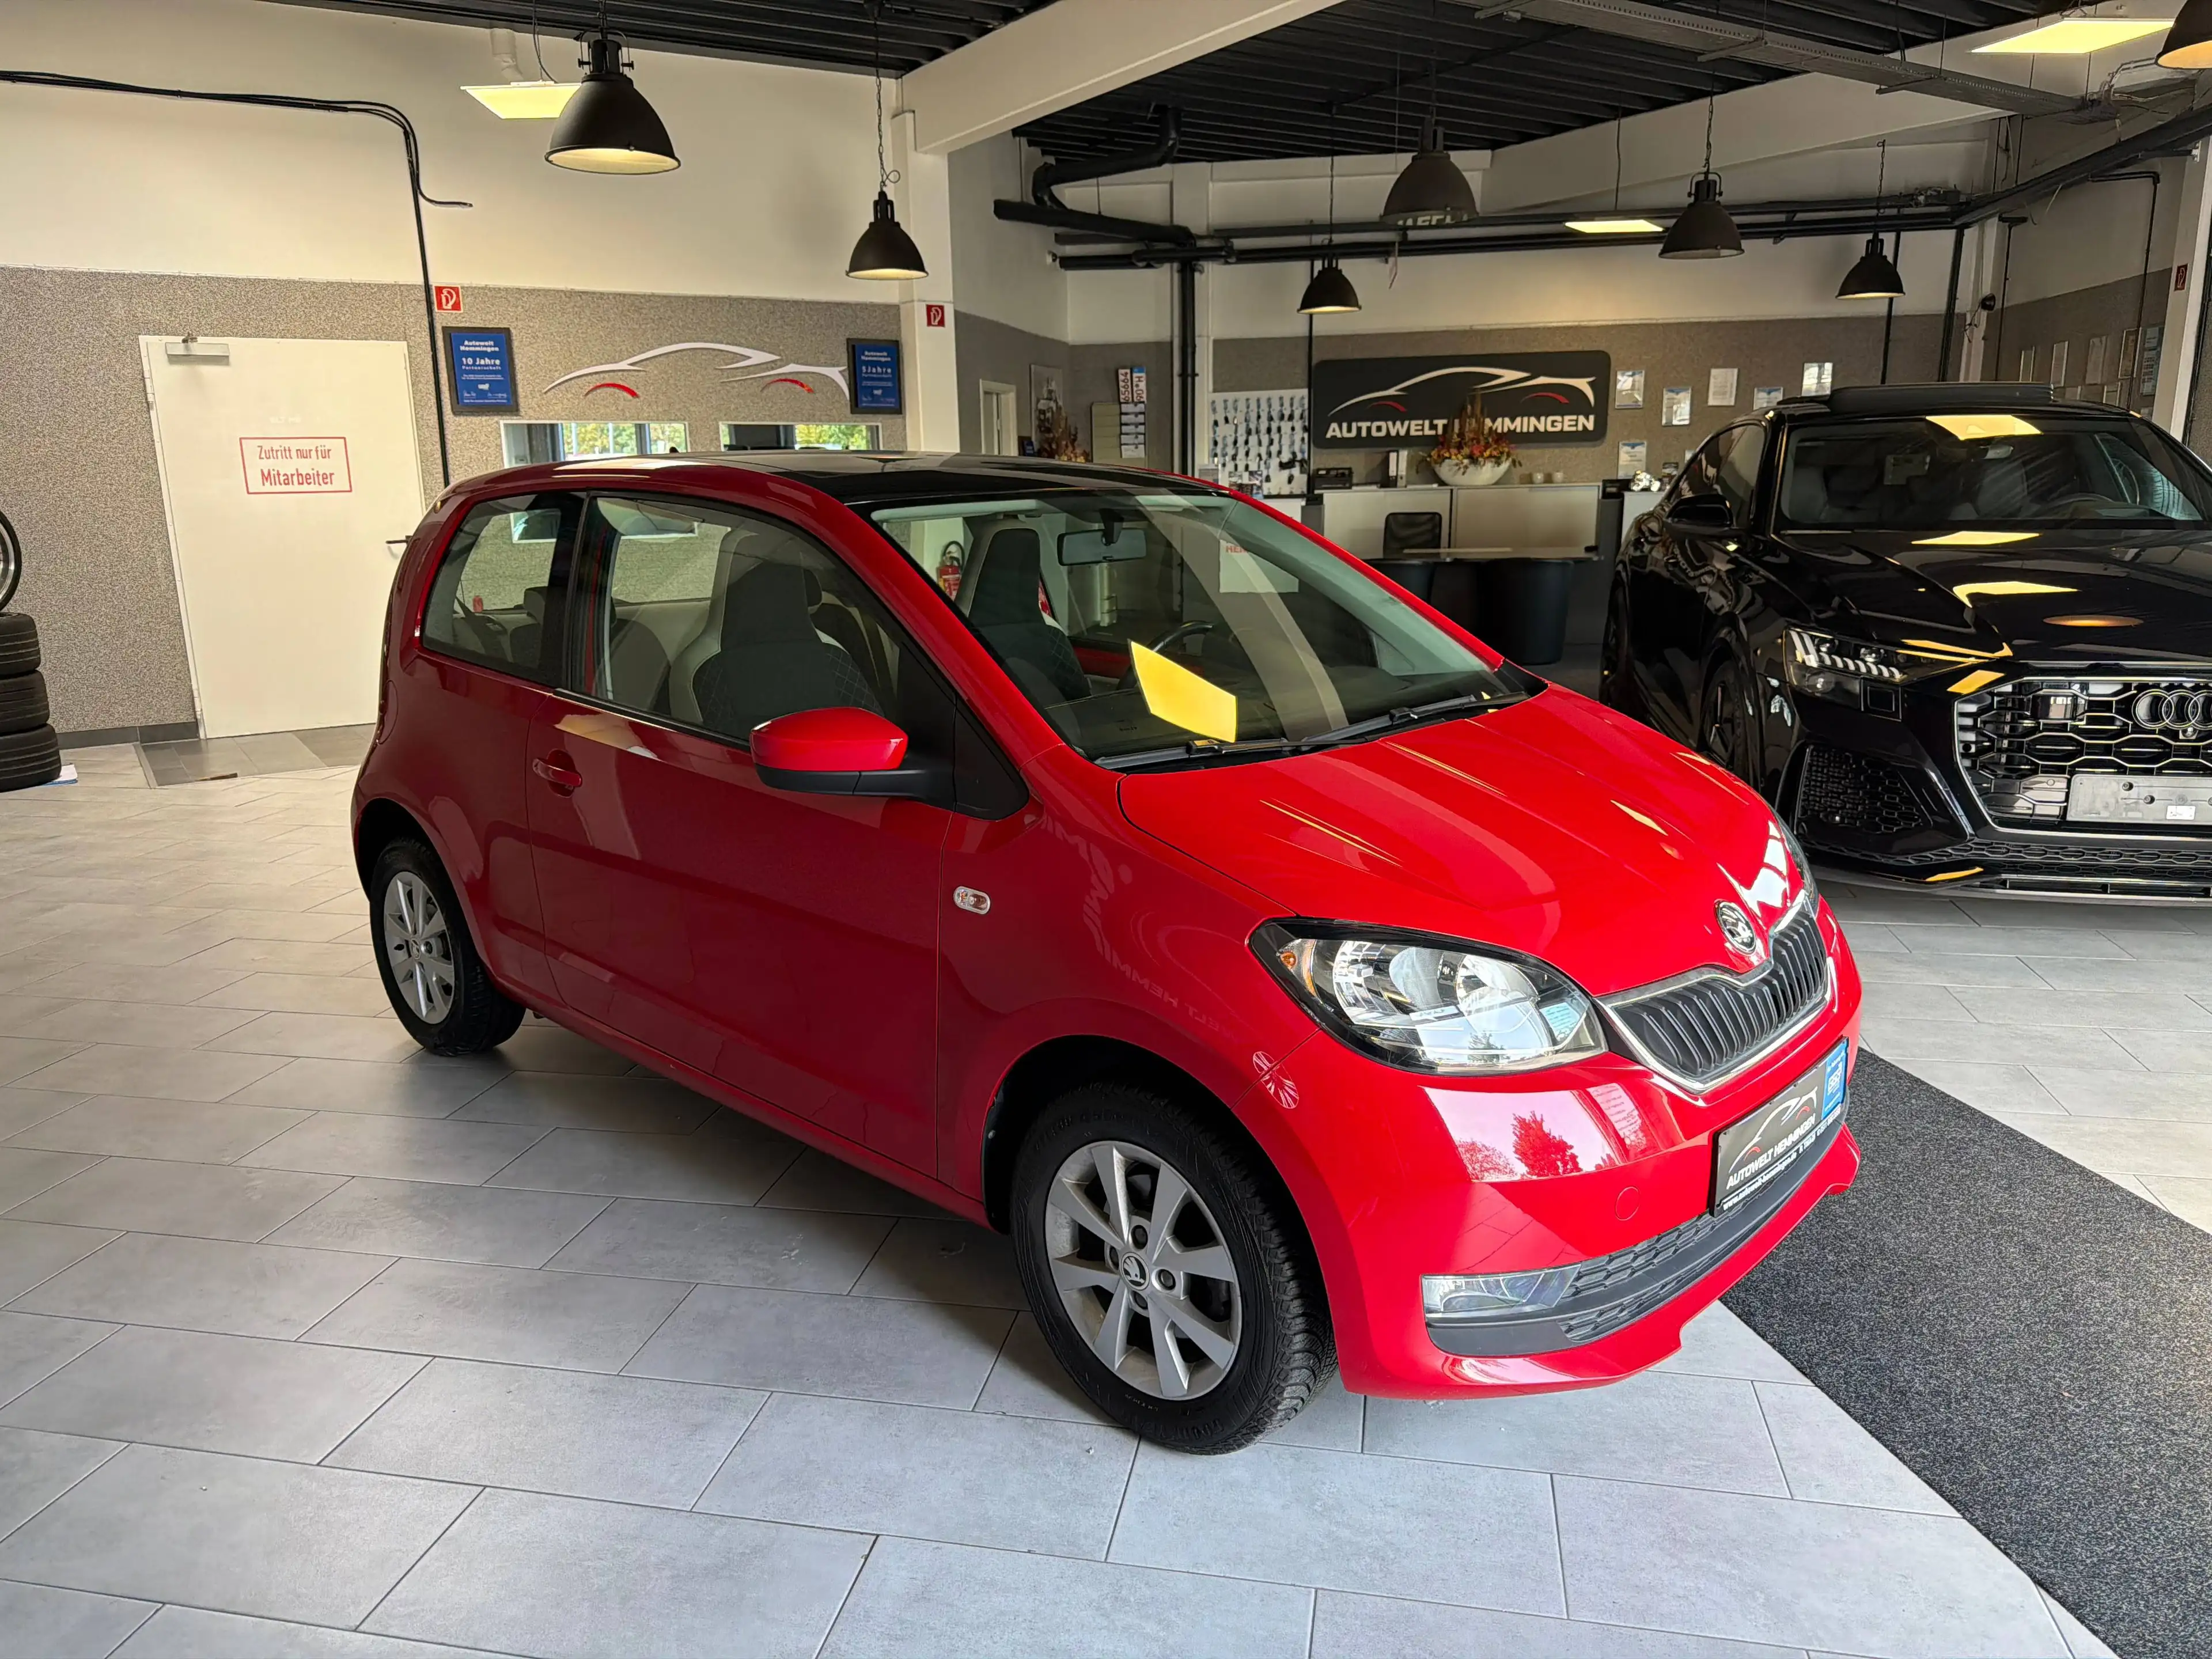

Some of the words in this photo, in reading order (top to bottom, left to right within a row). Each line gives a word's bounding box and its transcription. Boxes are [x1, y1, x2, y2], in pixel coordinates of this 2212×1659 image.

[476, 357, 501, 365] Jahre
[867, 366, 892, 374] Jahre
[1325, 419, 1448, 438] AUTOWELT
[257, 445, 293, 460] Zutritt
[296, 449, 313, 459] nur
[315, 445, 332, 460] für
[260, 468, 335, 486] Mitarbeiter
[1726, 1147, 1774, 1190] AUTOWELT
[1774, 1113, 1816, 1157] HEMMINGEN
